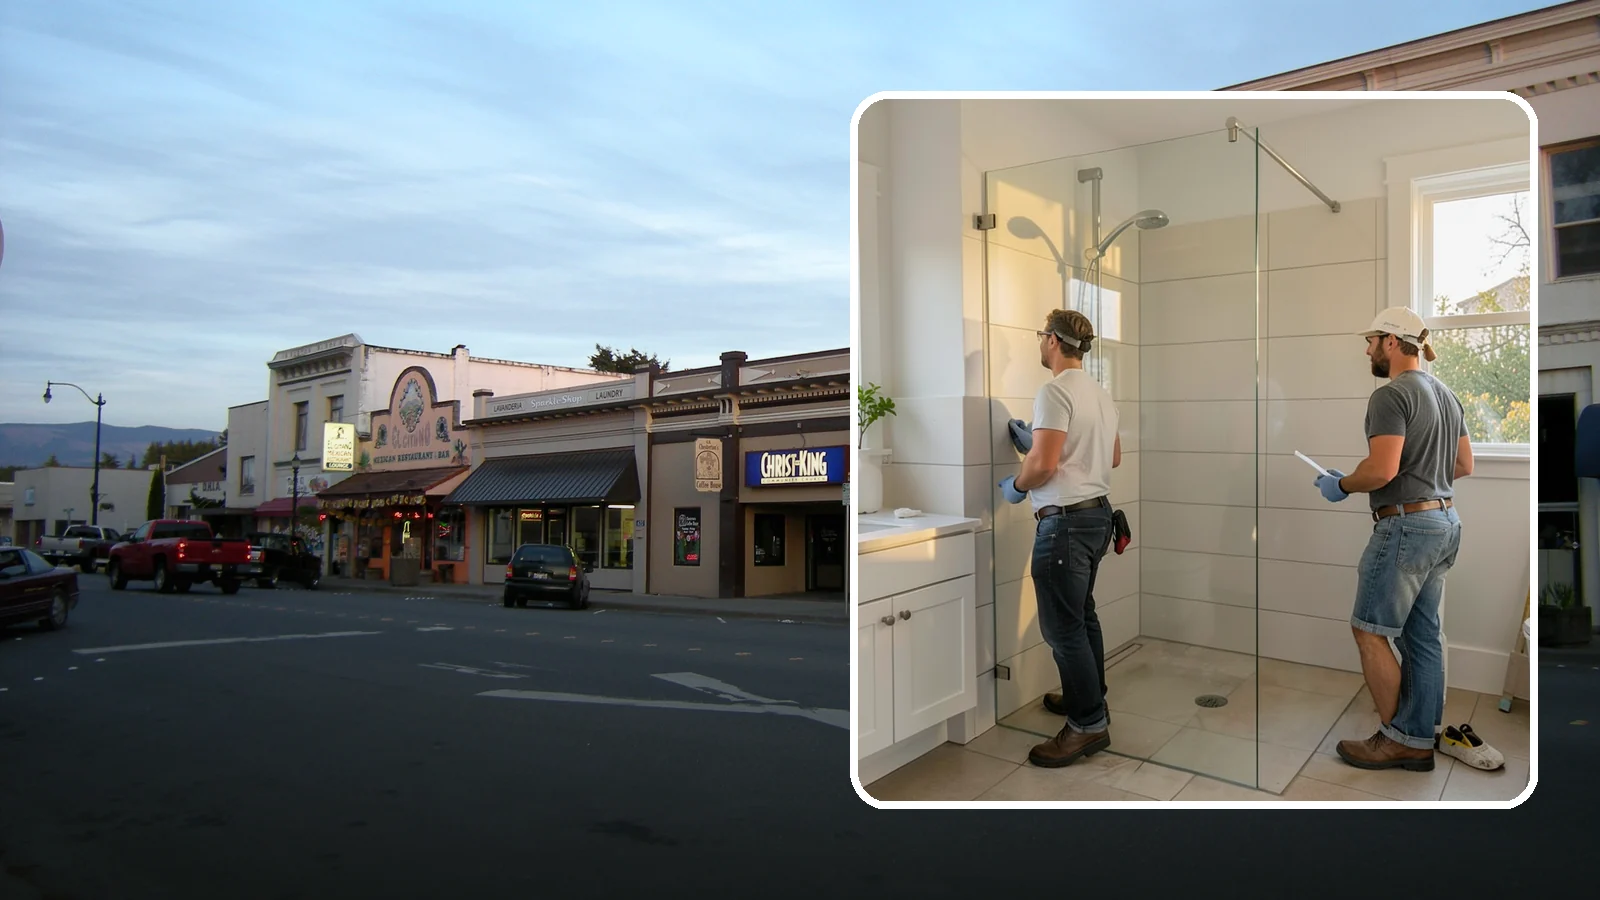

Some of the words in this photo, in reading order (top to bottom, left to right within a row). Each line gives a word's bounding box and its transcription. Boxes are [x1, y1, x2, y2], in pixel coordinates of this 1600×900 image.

[562, 394, 583, 405] Shop
[595, 388, 624, 400] LAUNDRY
[493, 402, 522, 412] LAVANDERIA
[374, 455, 396, 464] MEXICAN
[397, 450, 434, 462] RESTAURANT
[438, 450, 449, 459] BAR
